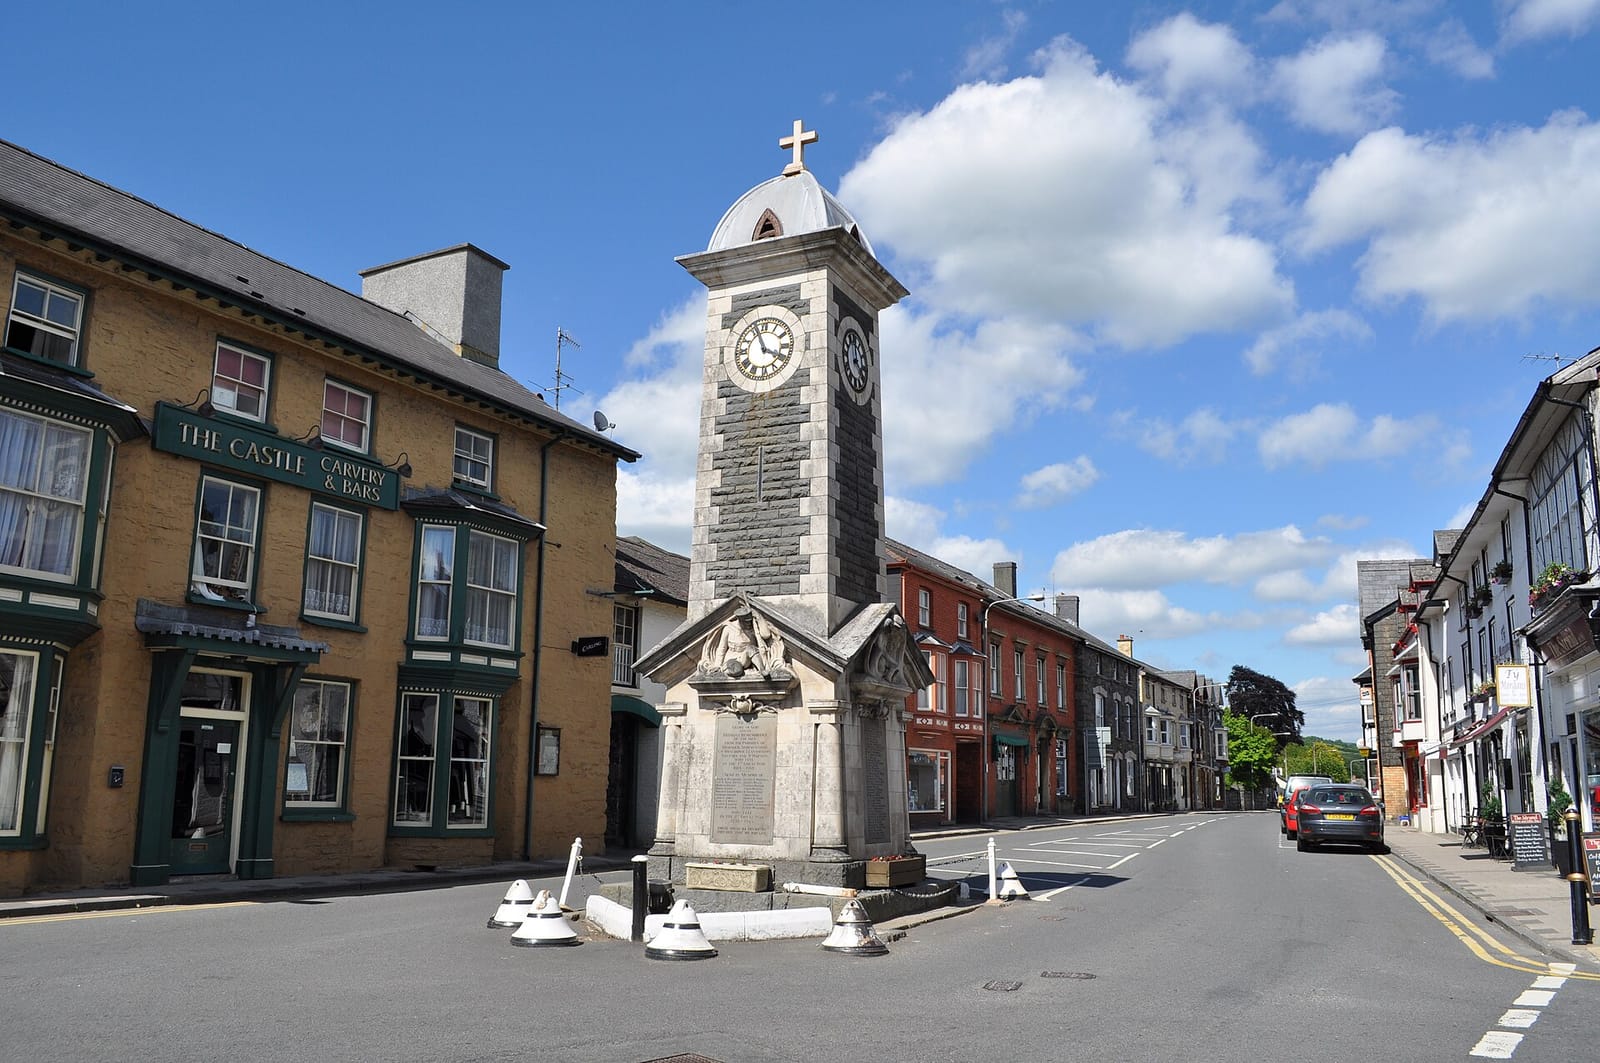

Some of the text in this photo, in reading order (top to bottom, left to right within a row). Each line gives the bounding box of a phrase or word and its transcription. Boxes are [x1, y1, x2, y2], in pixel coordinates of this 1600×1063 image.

[178, 421, 306, 476] THE CASTLE
[320, 456, 386, 487] CARVERY
[324, 474, 381, 502] & BARS
